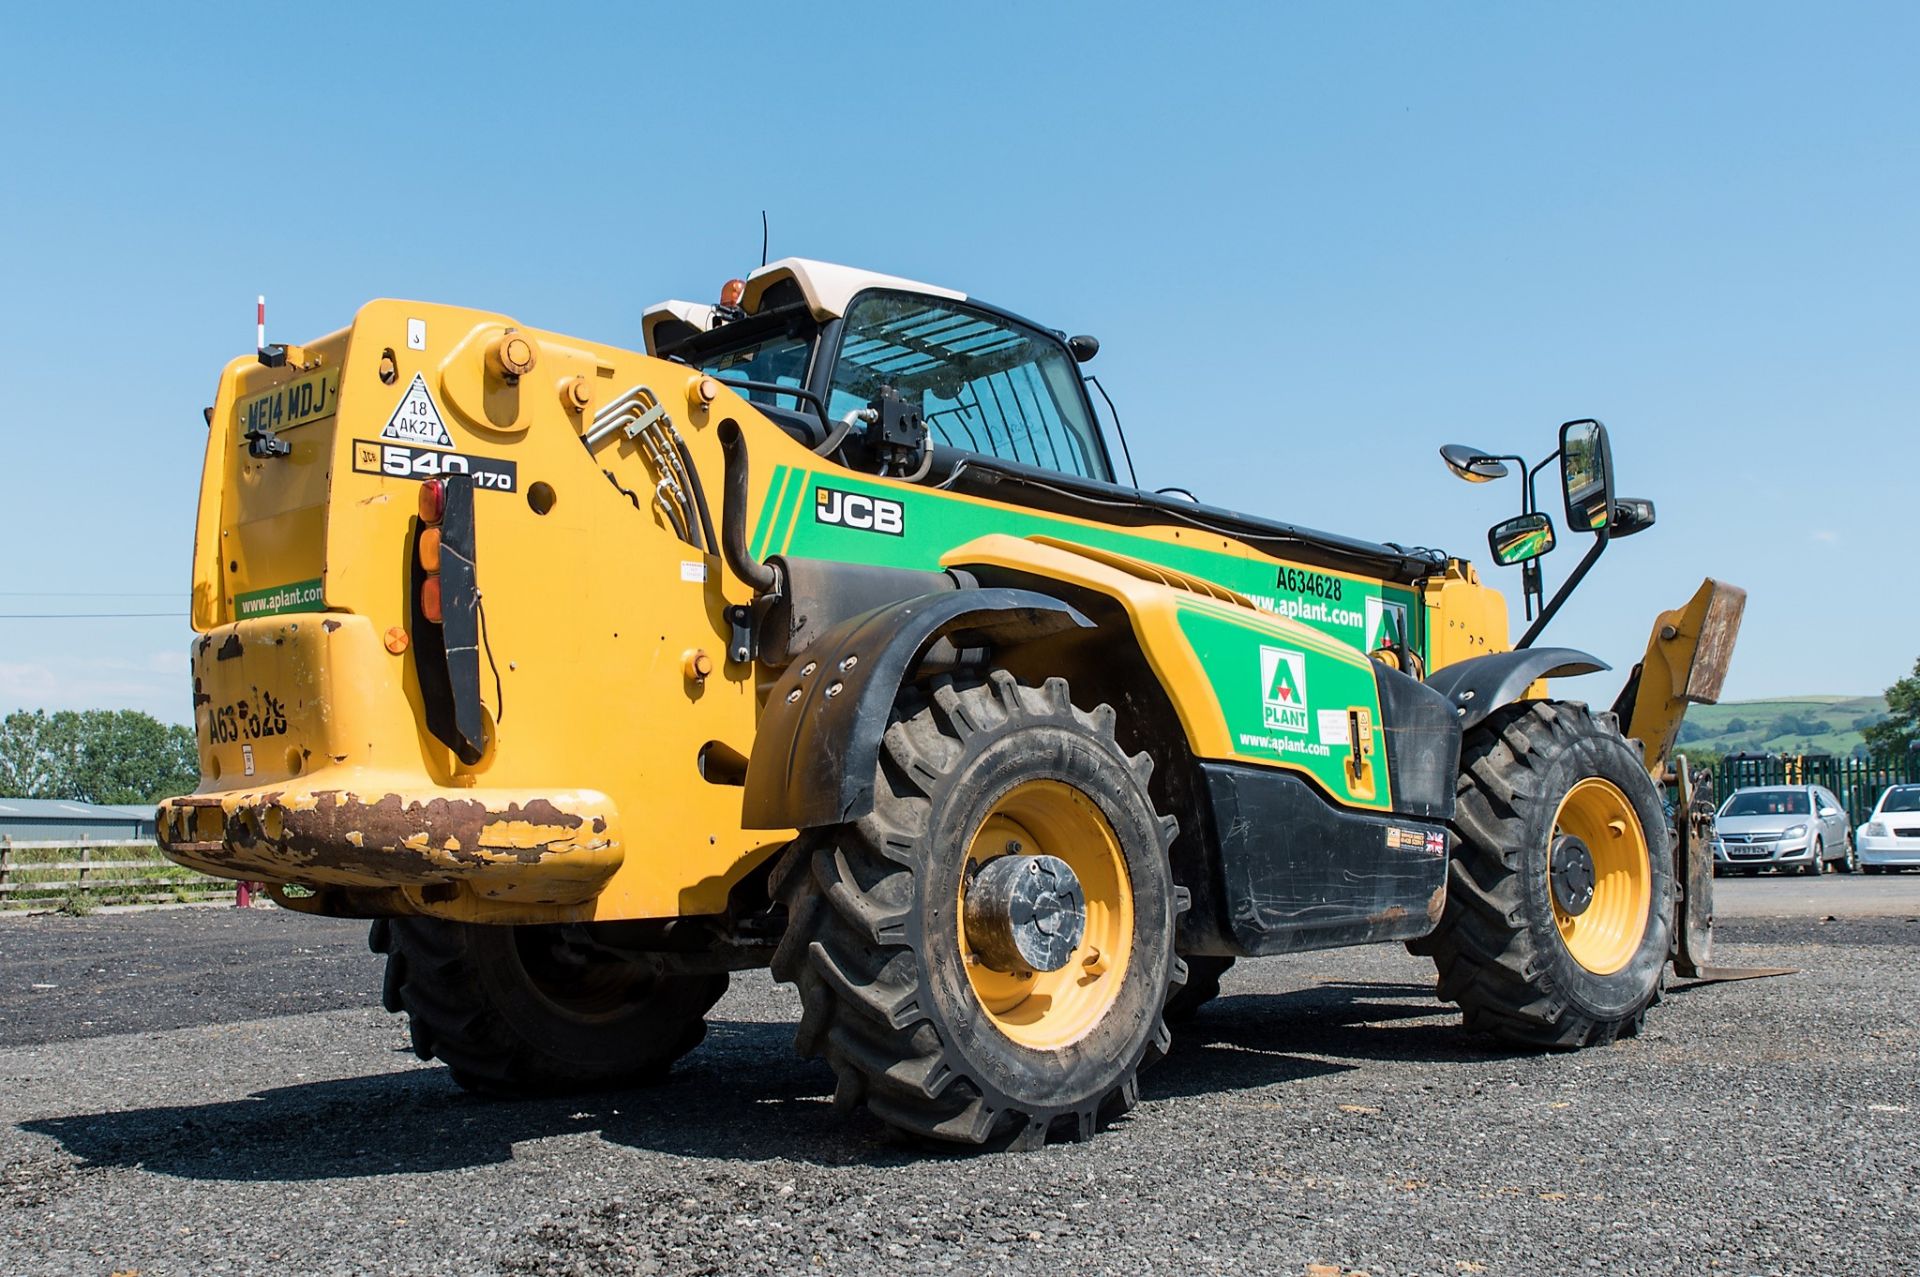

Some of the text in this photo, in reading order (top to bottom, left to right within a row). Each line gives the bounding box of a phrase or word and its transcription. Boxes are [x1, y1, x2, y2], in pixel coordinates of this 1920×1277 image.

[287, 377, 327, 422] MDJ
[410, 400, 427, 416] 18
[400, 417, 437, 436] AK2T
[817, 491, 904, 534] JCB
[1276, 566, 1342, 602] A634628
[1264, 706, 1306, 728] PLANT
[1239, 733, 1330, 757] www.aplant.com
